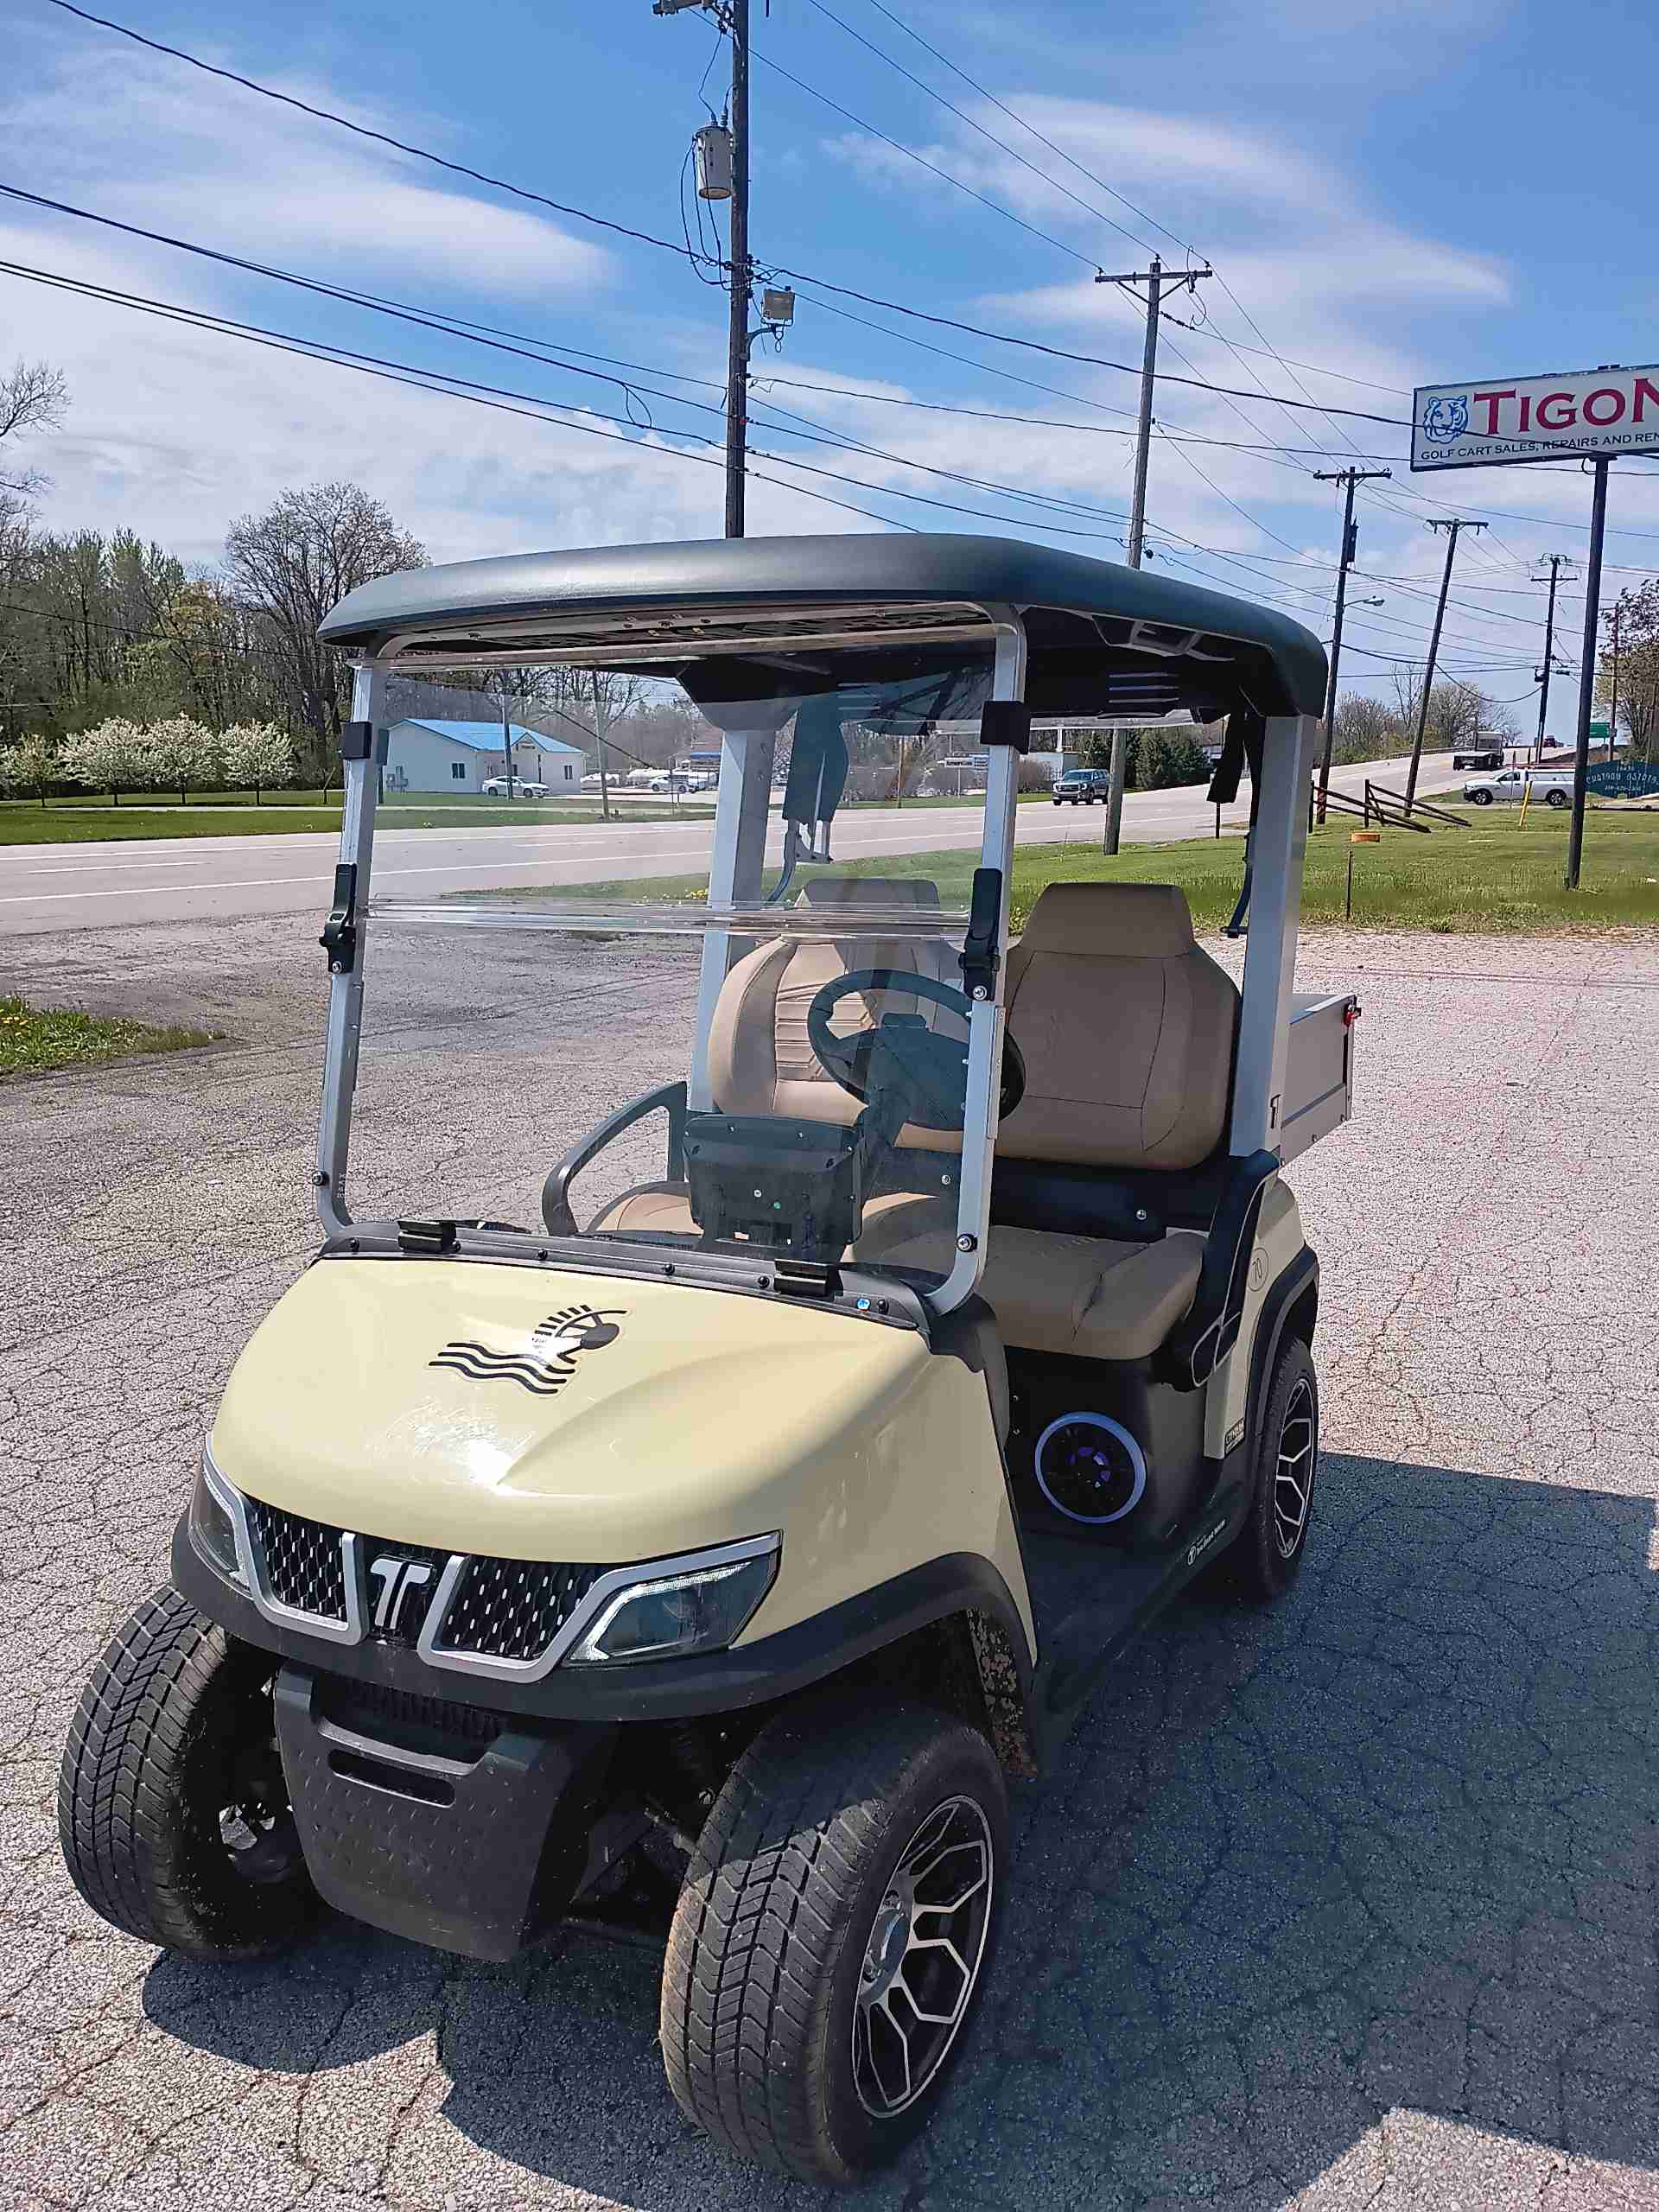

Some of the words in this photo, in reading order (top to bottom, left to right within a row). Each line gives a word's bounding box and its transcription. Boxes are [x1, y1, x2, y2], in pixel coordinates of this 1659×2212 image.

[1472, 377, 1659, 435] TIGON
[1421, 448, 1454, 460] GOLF
[1458, 446, 1493, 457] CART
[1495, 442, 1539, 454] SALES,
[1542, 436, 1599, 449] REPAIRS
[1602, 434, 1632, 446] AND
